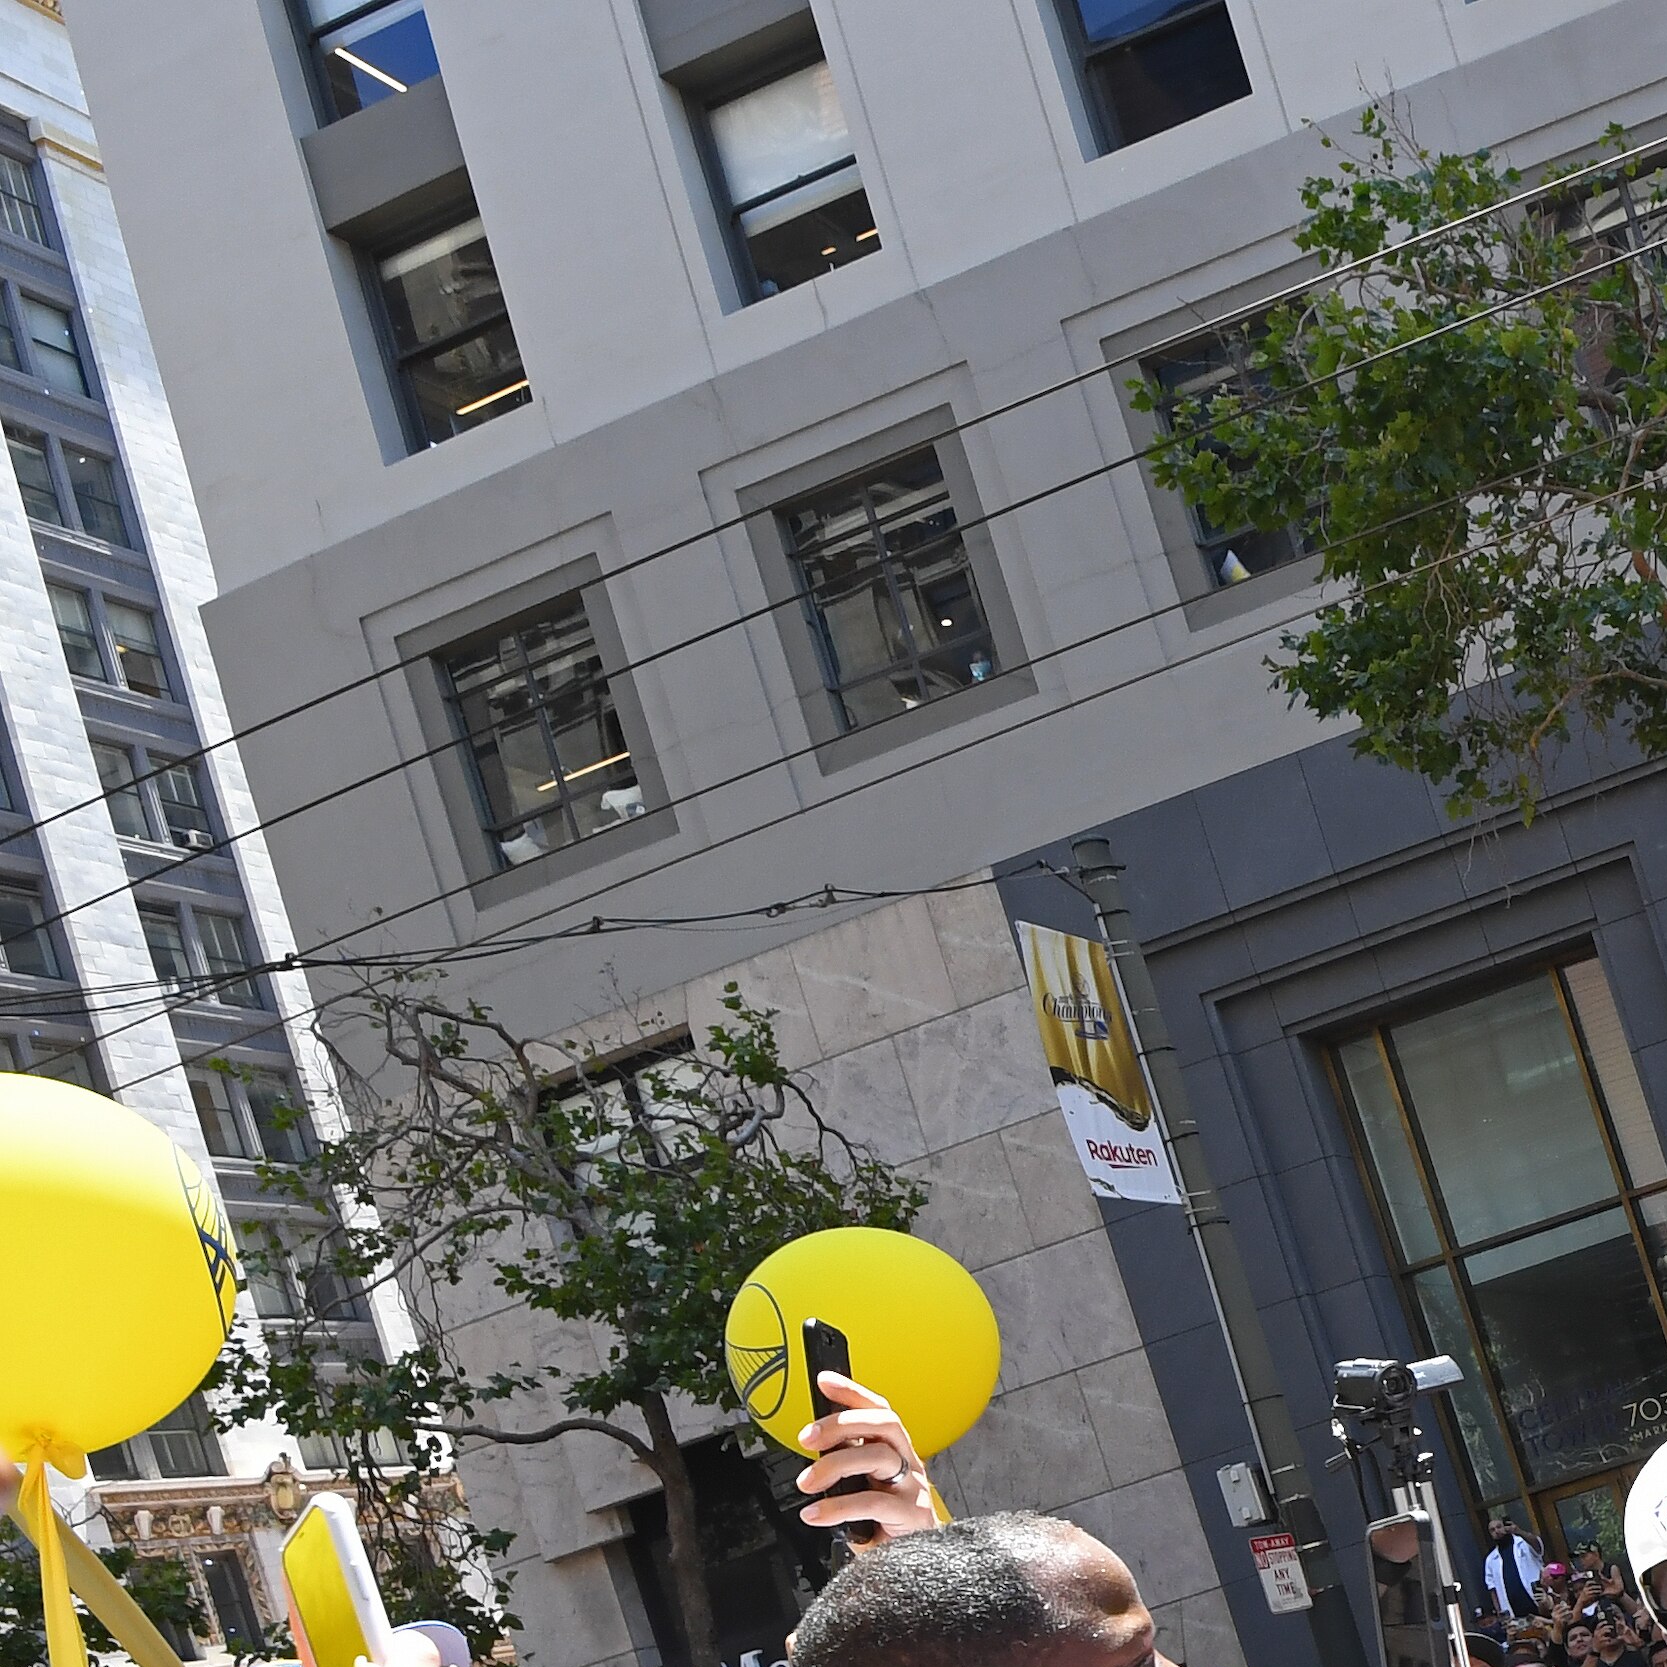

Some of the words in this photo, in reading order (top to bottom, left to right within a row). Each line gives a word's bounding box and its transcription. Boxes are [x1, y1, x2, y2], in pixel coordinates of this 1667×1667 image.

[1085, 1138, 1158, 1167] Rakuten
[1274, 1568, 1290, 1580] ANY
[1276, 1582, 1297, 1596] TIME
